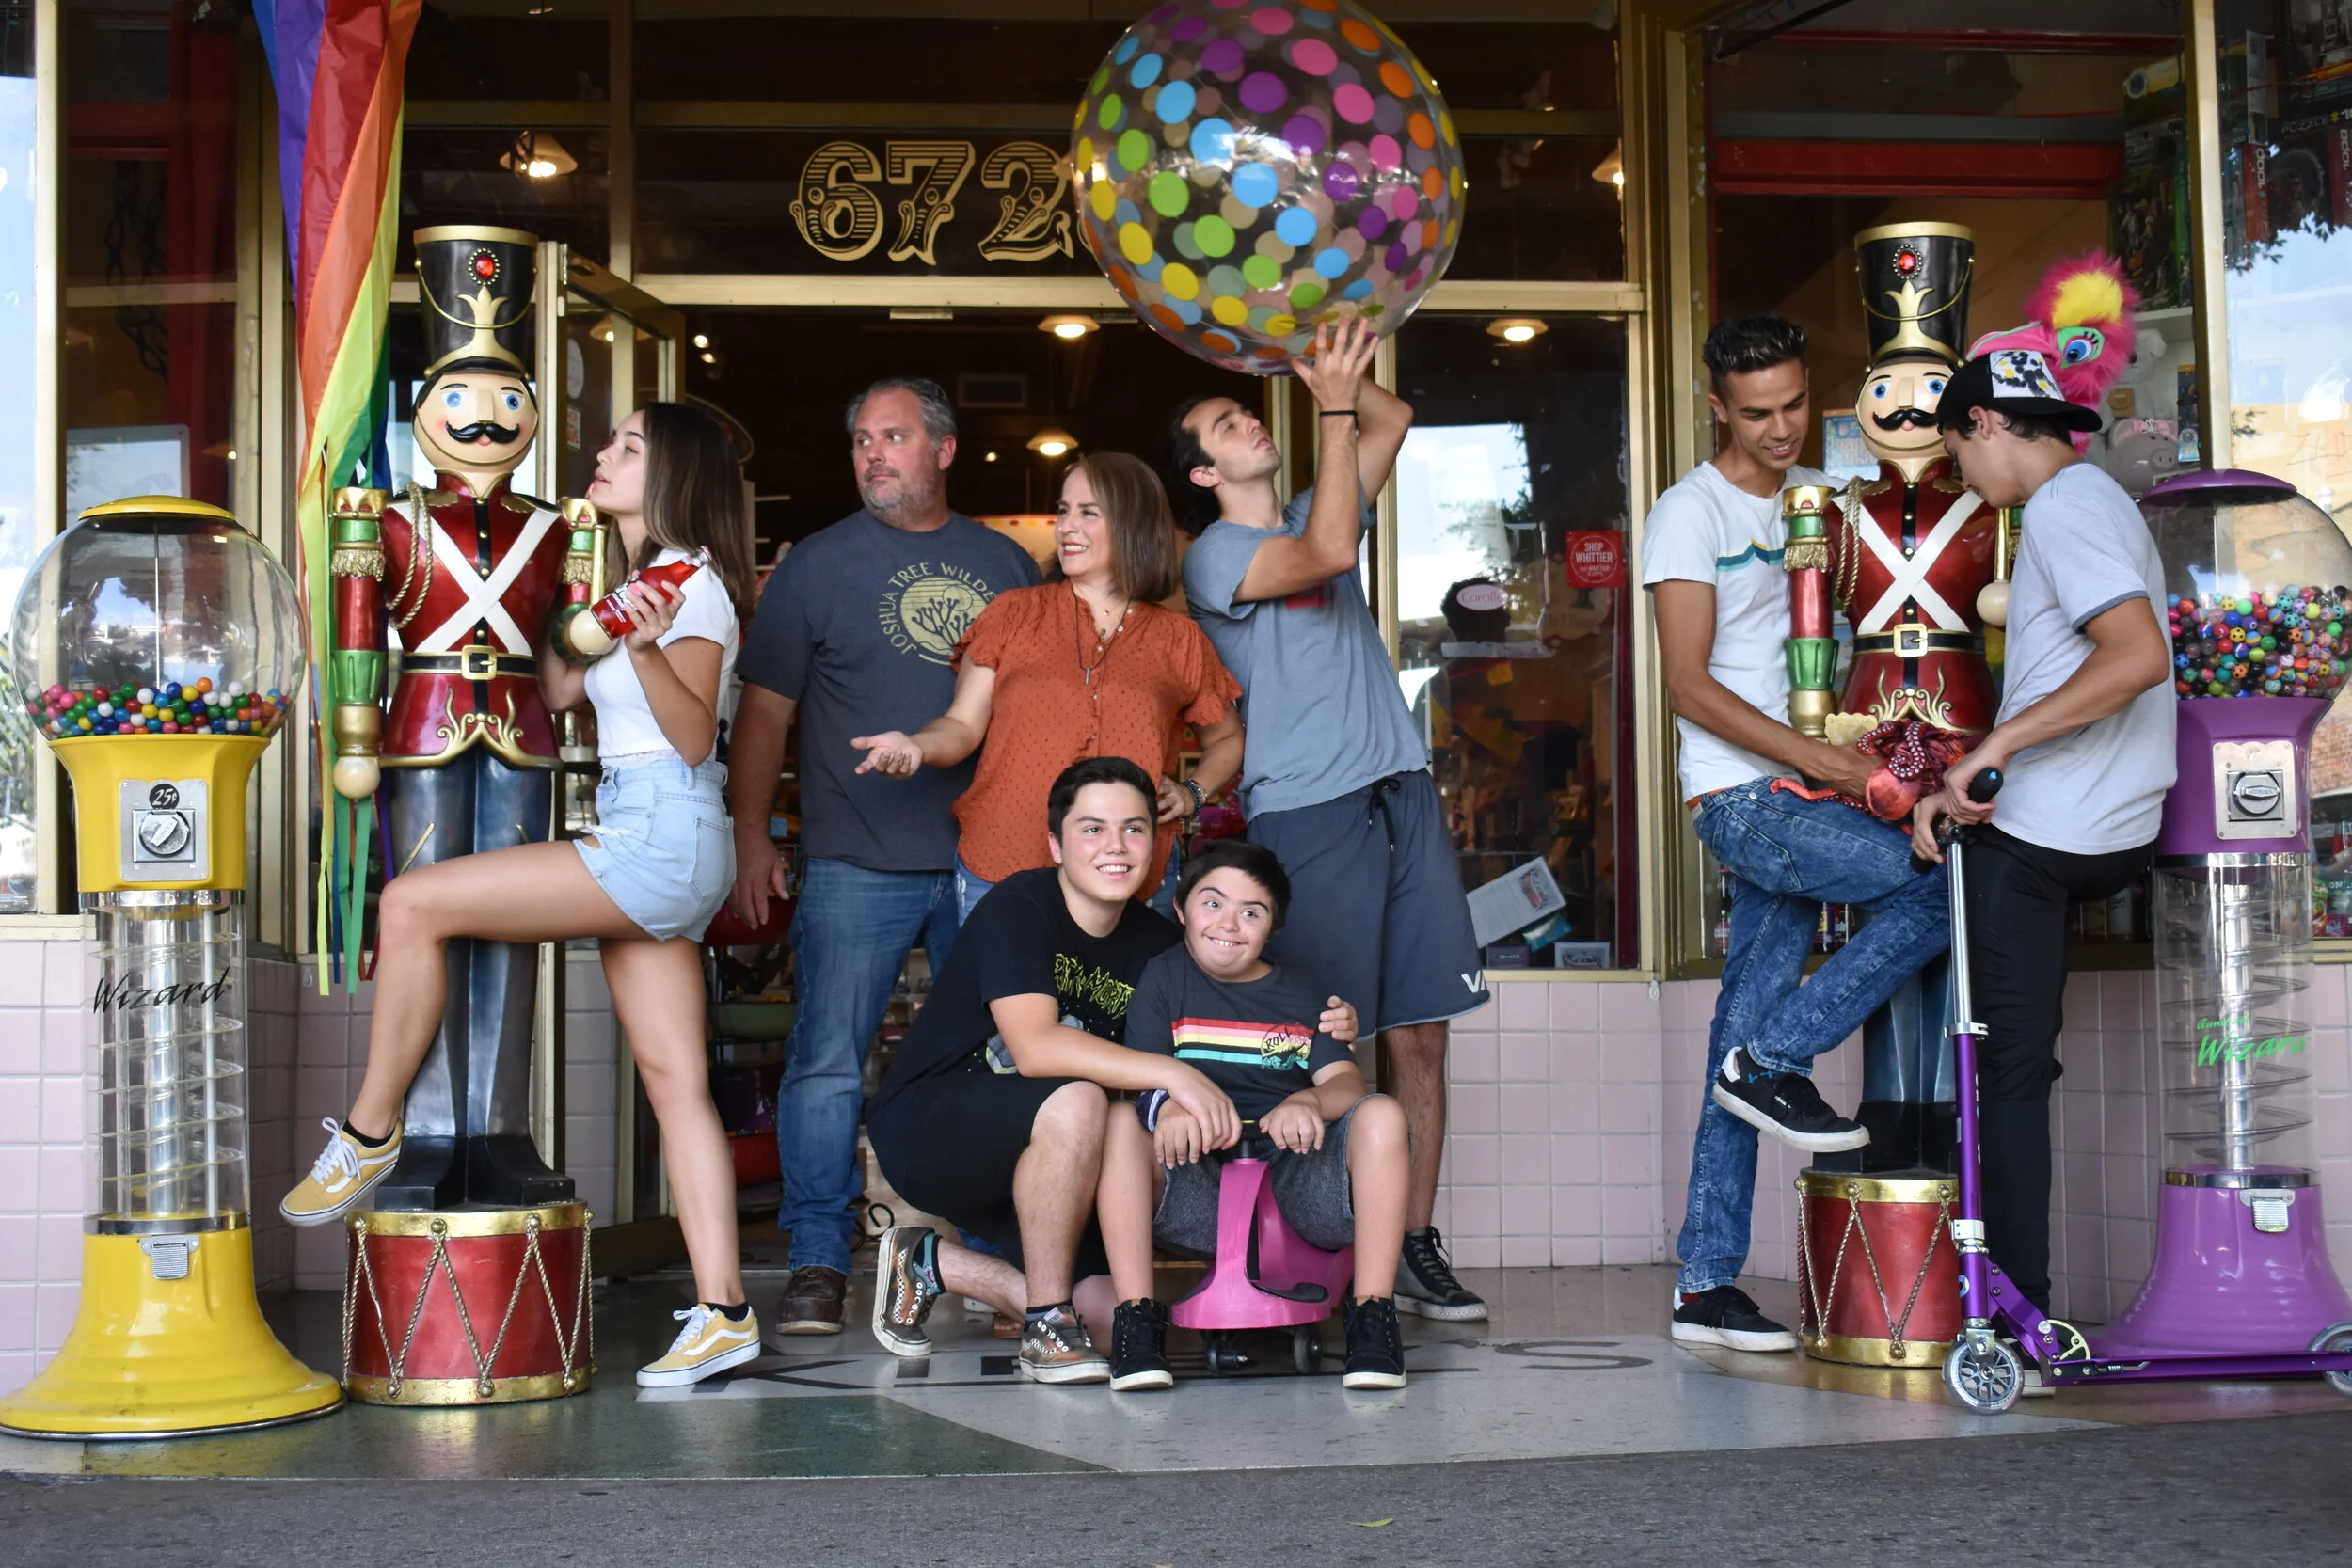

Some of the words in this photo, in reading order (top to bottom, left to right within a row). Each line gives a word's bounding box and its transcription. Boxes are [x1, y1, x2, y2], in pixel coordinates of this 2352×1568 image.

[2280, 119, 2328, 135] PUZZLE
[2340, 128, 2350, 171] 1000
[2256, 147, 2265, 190] 1000
[789, 141, 1093, 266] 672
[1576, 552, 1613, 562] WHITTIER
[1584, 542, 1604, 552] SHOP
[887, 562, 934, 588] TREE
[878, 592, 917, 655] JOSHUA
[151, 788, 178, 807] 25¢
[93, 966, 230, 1014] Wizard
[1264, 1026, 1293, 1050] ROLL
